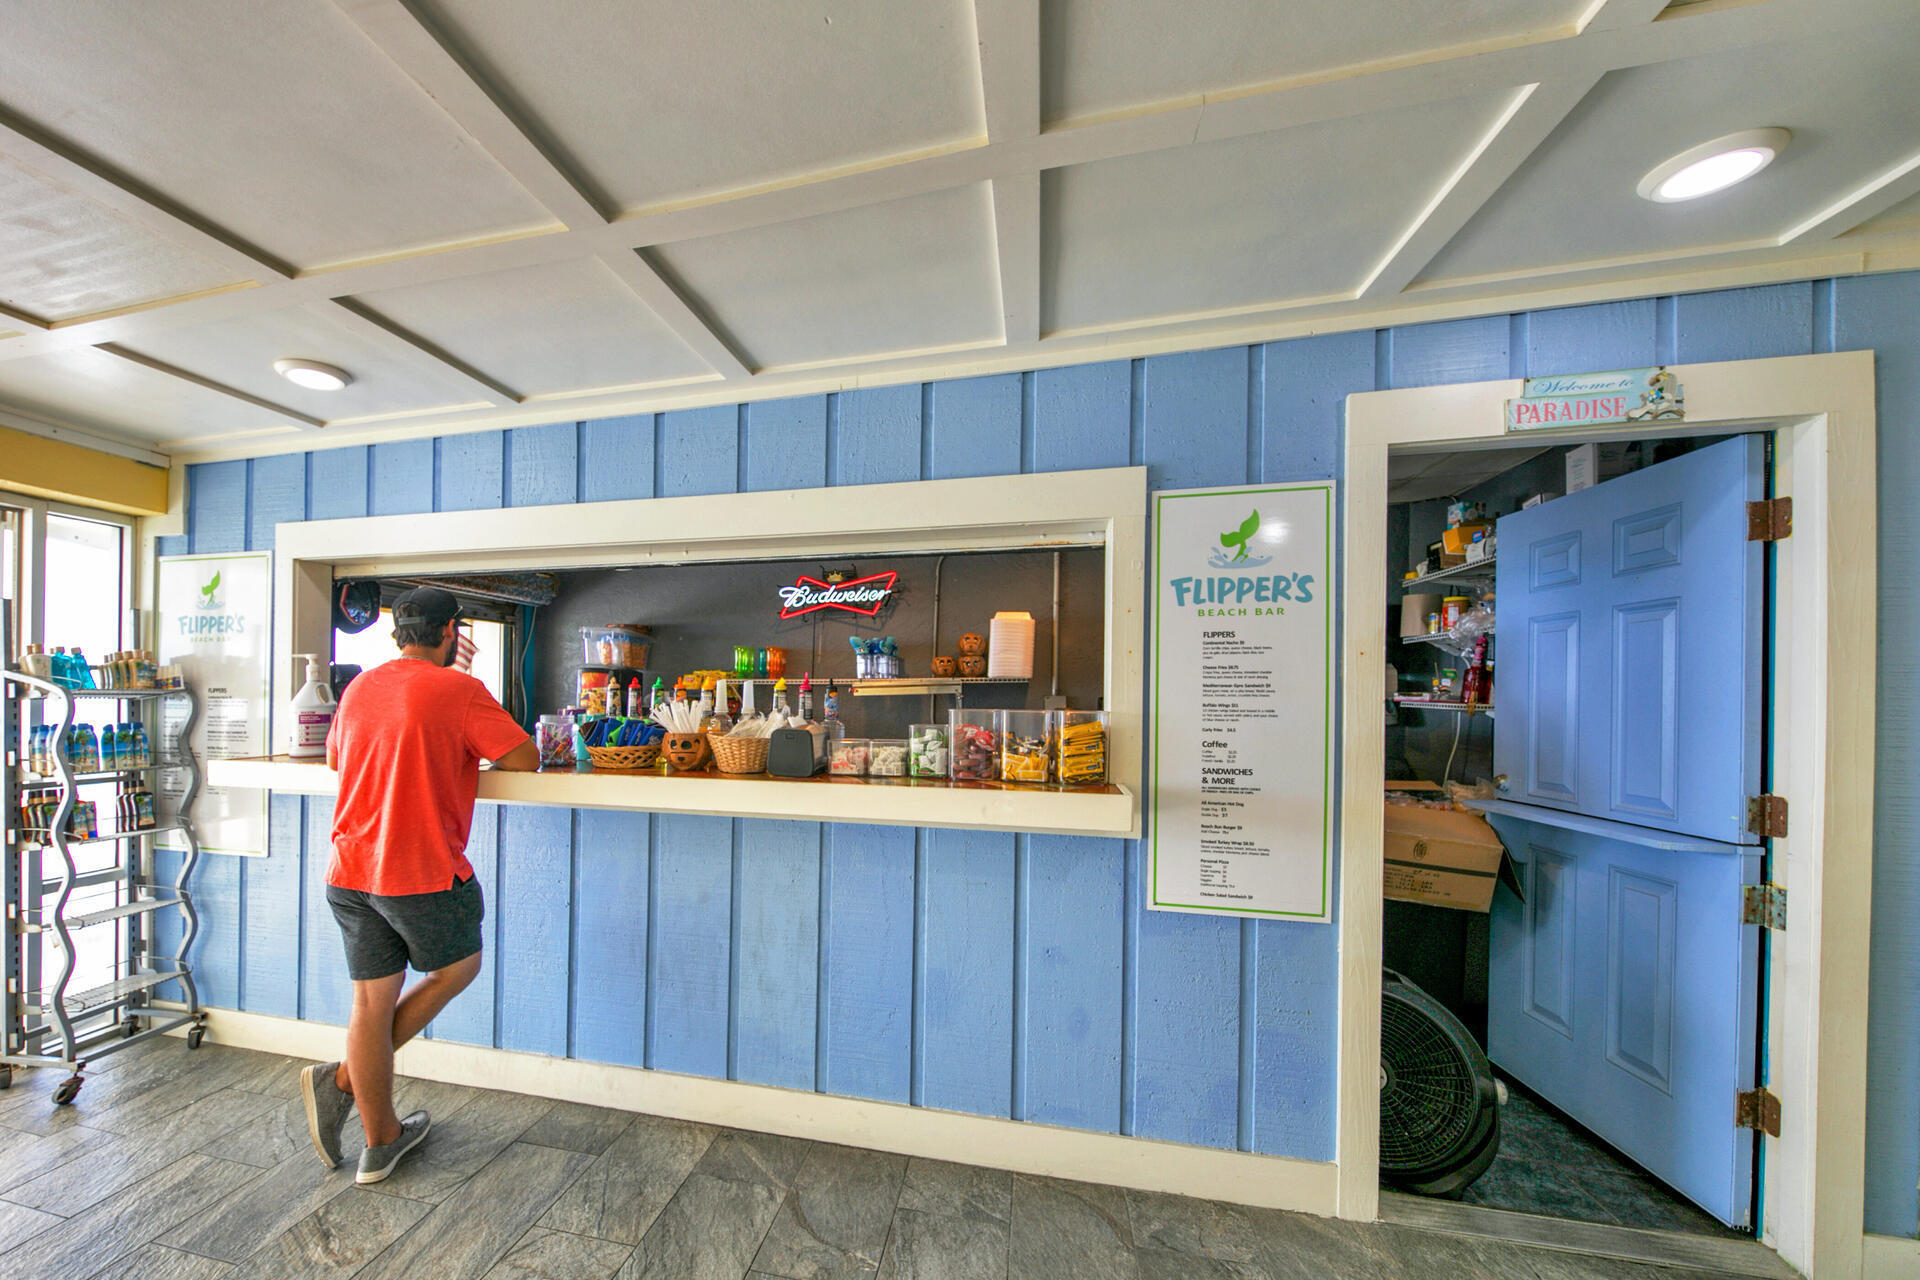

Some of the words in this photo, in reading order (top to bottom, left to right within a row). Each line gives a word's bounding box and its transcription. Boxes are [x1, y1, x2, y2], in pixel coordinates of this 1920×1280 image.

[1533, 378, 1616, 393] Welcome
[1619, 378, 1634, 387] to
[1516, 397, 1627, 424] PARADISE
[1170, 572, 1314, 607] FLIPPER'S
[778, 585, 891, 608] Budweiser
[1197, 608, 1247, 617] BEACH
[1255, 607, 1286, 616] BAR
[178, 615, 245, 635] FLIPPER'S
[1203, 631, 1236, 639] FLIPPERS
[1202, 740, 1228, 748] Coffee
[1202, 767, 1253, 776] SANDWICHES
[1201, 776, 1208, 784] &
[1211, 777, 1236, 785] MORE
